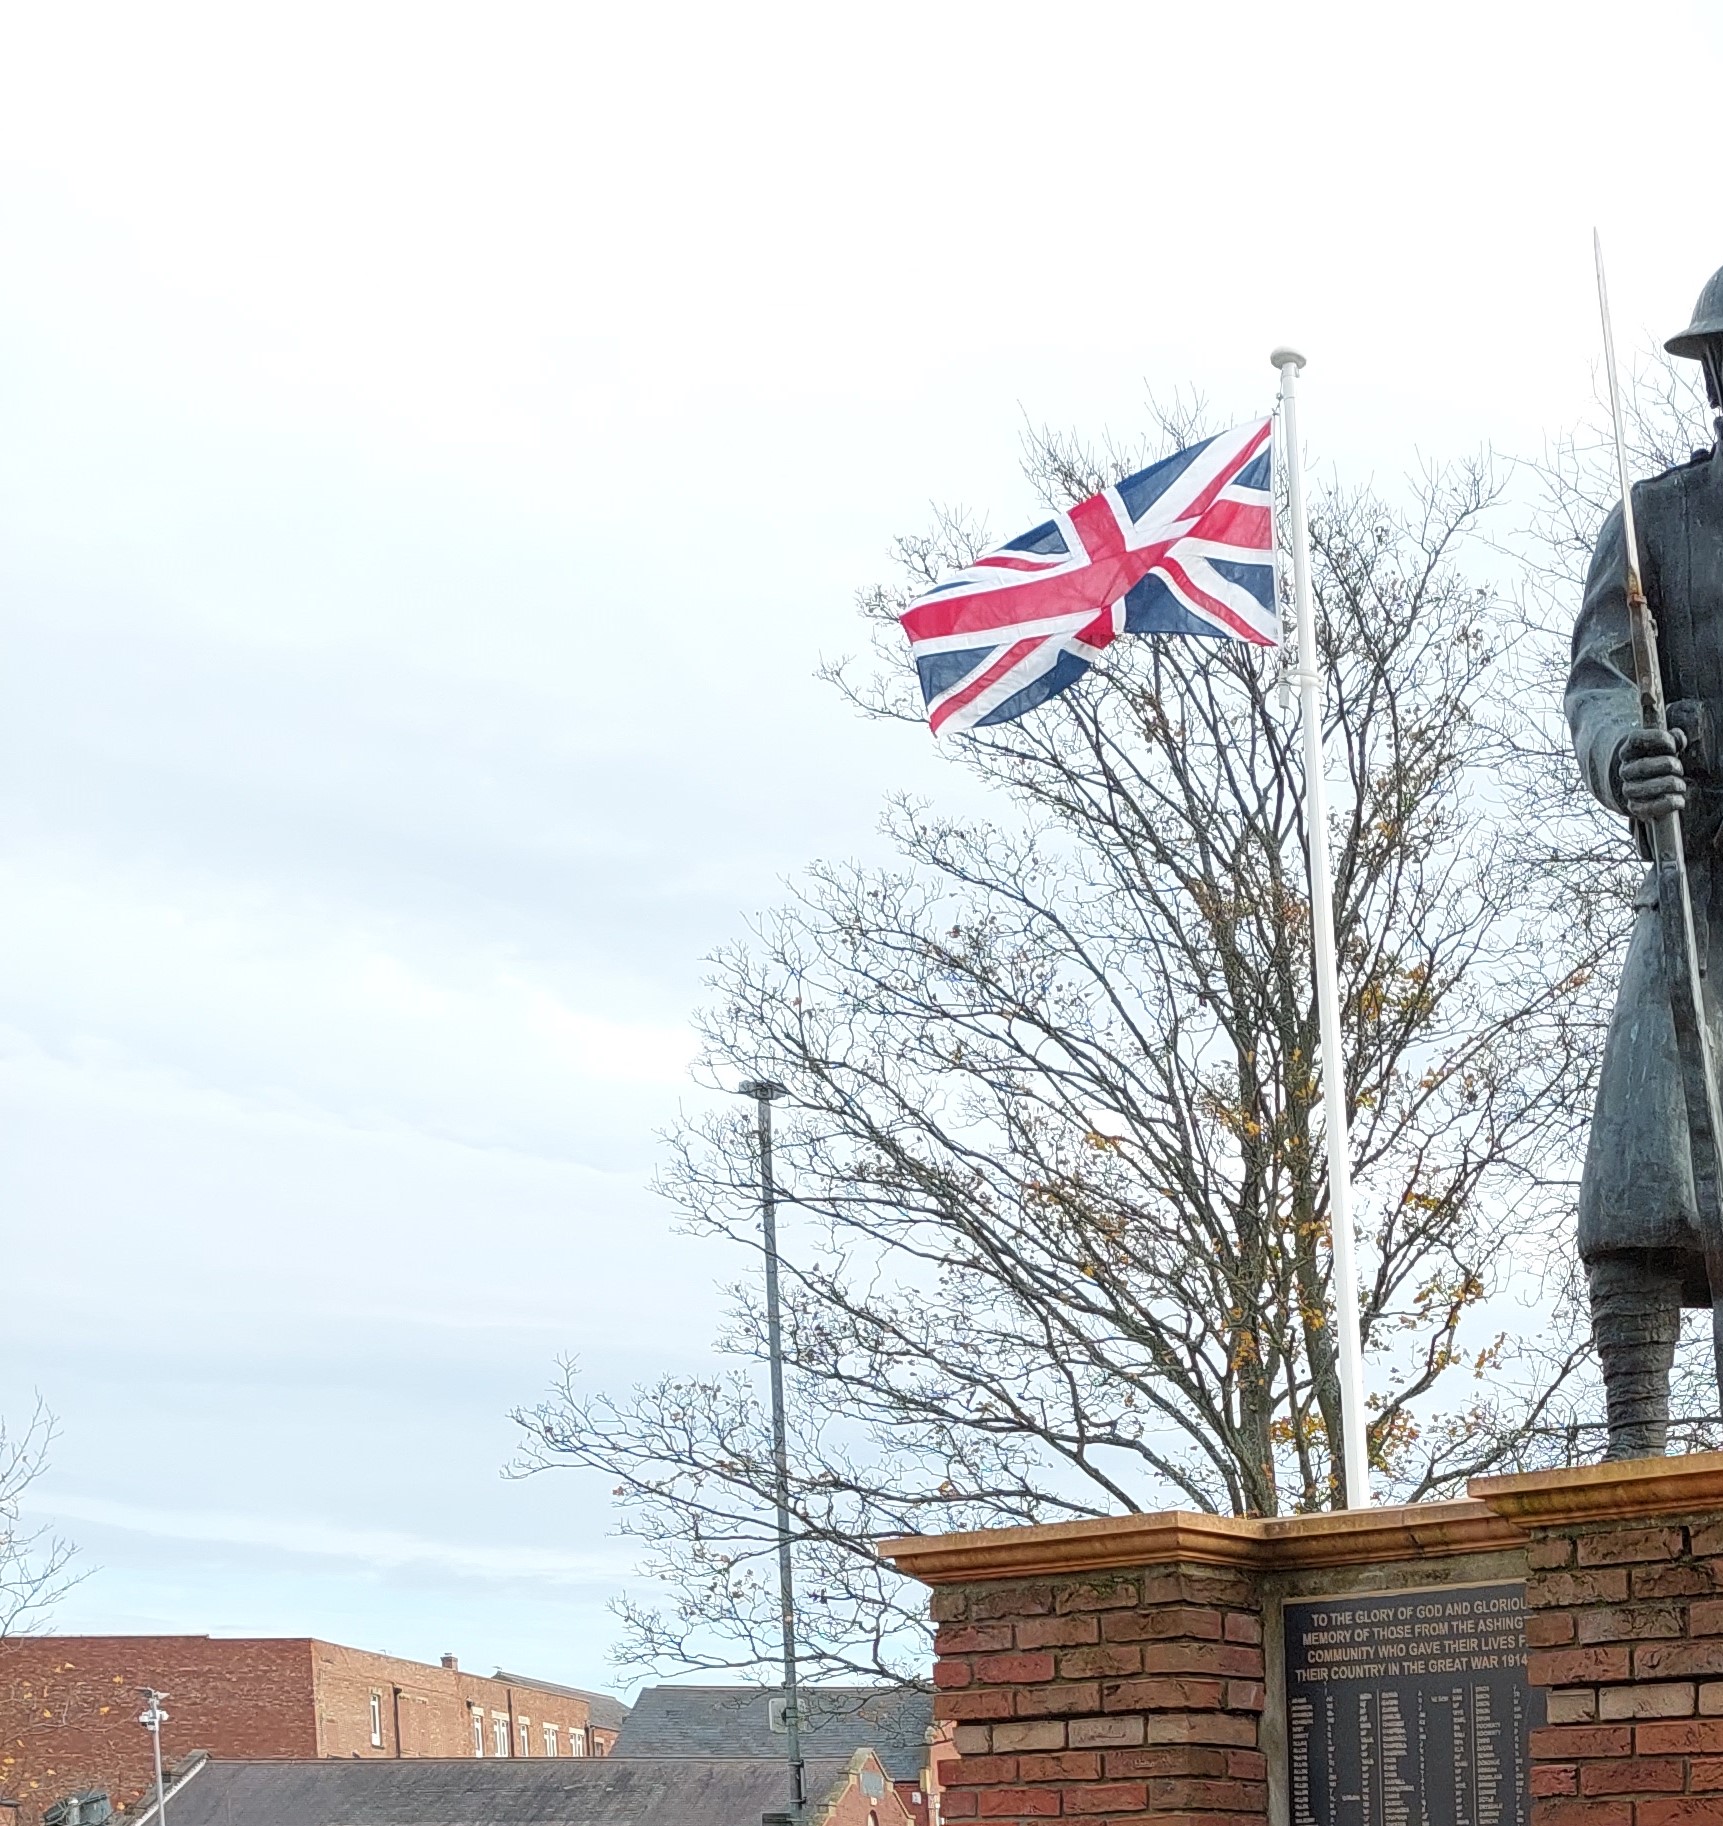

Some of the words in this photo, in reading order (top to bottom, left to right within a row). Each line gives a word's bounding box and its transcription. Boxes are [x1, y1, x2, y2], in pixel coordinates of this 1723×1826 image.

[1311, 1613, 1328, 1627] TO
[1329, 1611, 1353, 1626] THE
[1355, 1607, 1395, 1624] GLORY
[1397, 1606, 1414, 1620] OF
[1416, 1604, 1443, 1619] GOD
[1445, 1601, 1471, 1617] AND
[1302, 1629, 1352, 1646] MEMORY
[1354, 1628, 1370, 1642] OF
[1372, 1624, 1413, 1640] THOSE
[1414, 1621, 1448, 1638] FROM
[1451, 1619, 1476, 1634] THE
[1307, 1645, 1376, 1663] COMMUNITY
[1378, 1643, 1406, 1659] WHO
[1408, 1641, 1441, 1656] GAVE
[1443, 1638, 1479, 1654] THEIR
[1481, 1635, 1516, 1651] LIVES
[1294, 1667, 1329, 1683] THEIR
[1330, 1663, 1387, 1680] COUNTRY
[1388, 1661, 1400, 1676] IN
[1402, 1660, 1426, 1676] THE
[1428, 1657, 1468, 1673] GREAT
[1470, 1655, 1499, 1671] WAR
